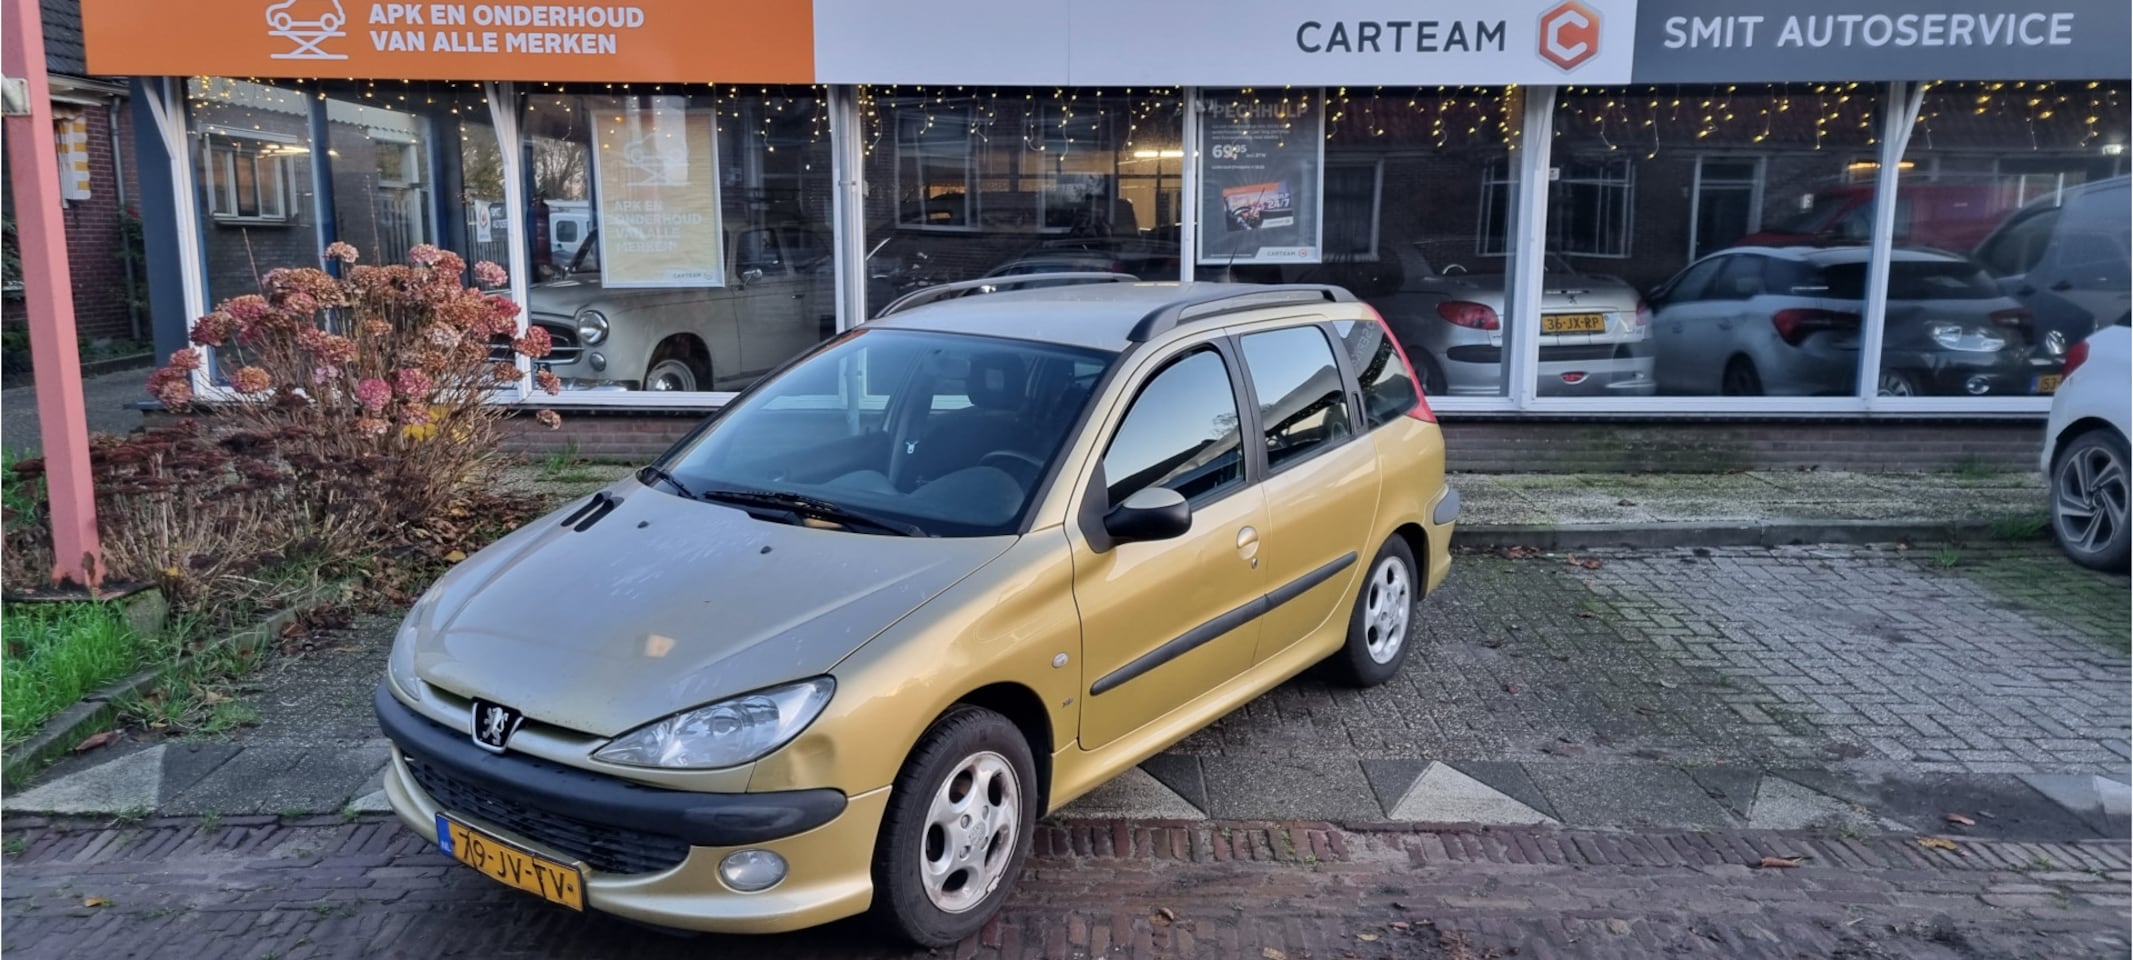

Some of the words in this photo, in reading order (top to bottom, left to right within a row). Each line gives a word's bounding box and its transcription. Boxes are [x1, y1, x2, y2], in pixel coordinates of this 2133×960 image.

[369, 4, 424, 24] APK
[430, 5, 466, 25] EN
[473, 6, 645, 27] ONDERHOUD
[1296, 20, 1506, 53] CARTEAM
[1664, 16, 1764, 48] SMIT
[1777, 13, 2075, 47] AUTOSERVICE
[369, 31, 425, 51] VAN
[433, 32, 498, 52] ALLE
[506, 33, 617, 54] MERKEN
[1213, 103, 1308, 118] PECHHULP
[614, 200, 641, 211] APK
[1547, 317, 1599, 330] 36-JX-RP
[459, 831, 565, 900] 79-JV-TV
